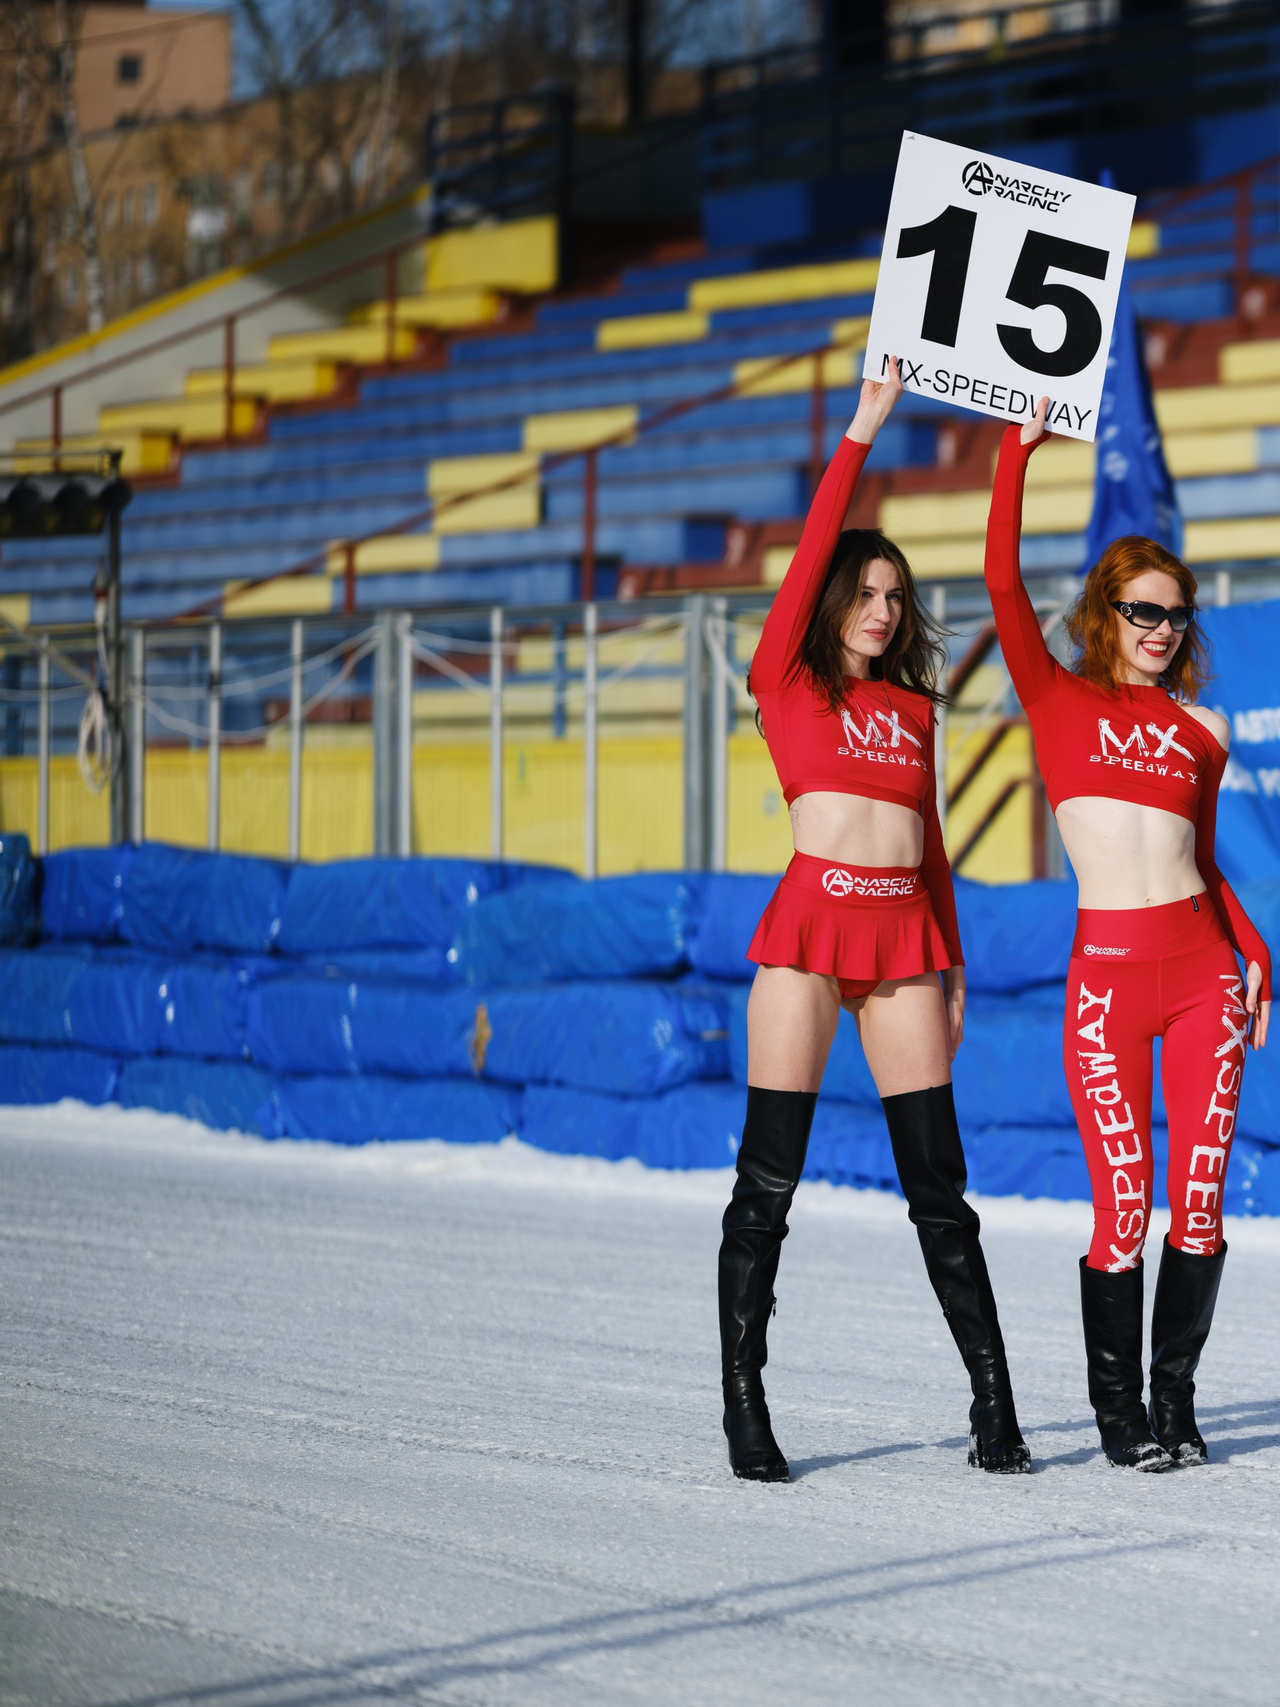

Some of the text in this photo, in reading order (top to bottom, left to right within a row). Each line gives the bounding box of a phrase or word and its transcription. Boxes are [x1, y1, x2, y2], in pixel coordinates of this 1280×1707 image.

[994, 186, 1060, 213] RACING
[896, 205, 1109, 377] 15
[841, 709, 922, 749] MX
[1098, 718, 1195, 762] MX
[854, 881, 914, 897] RACING
